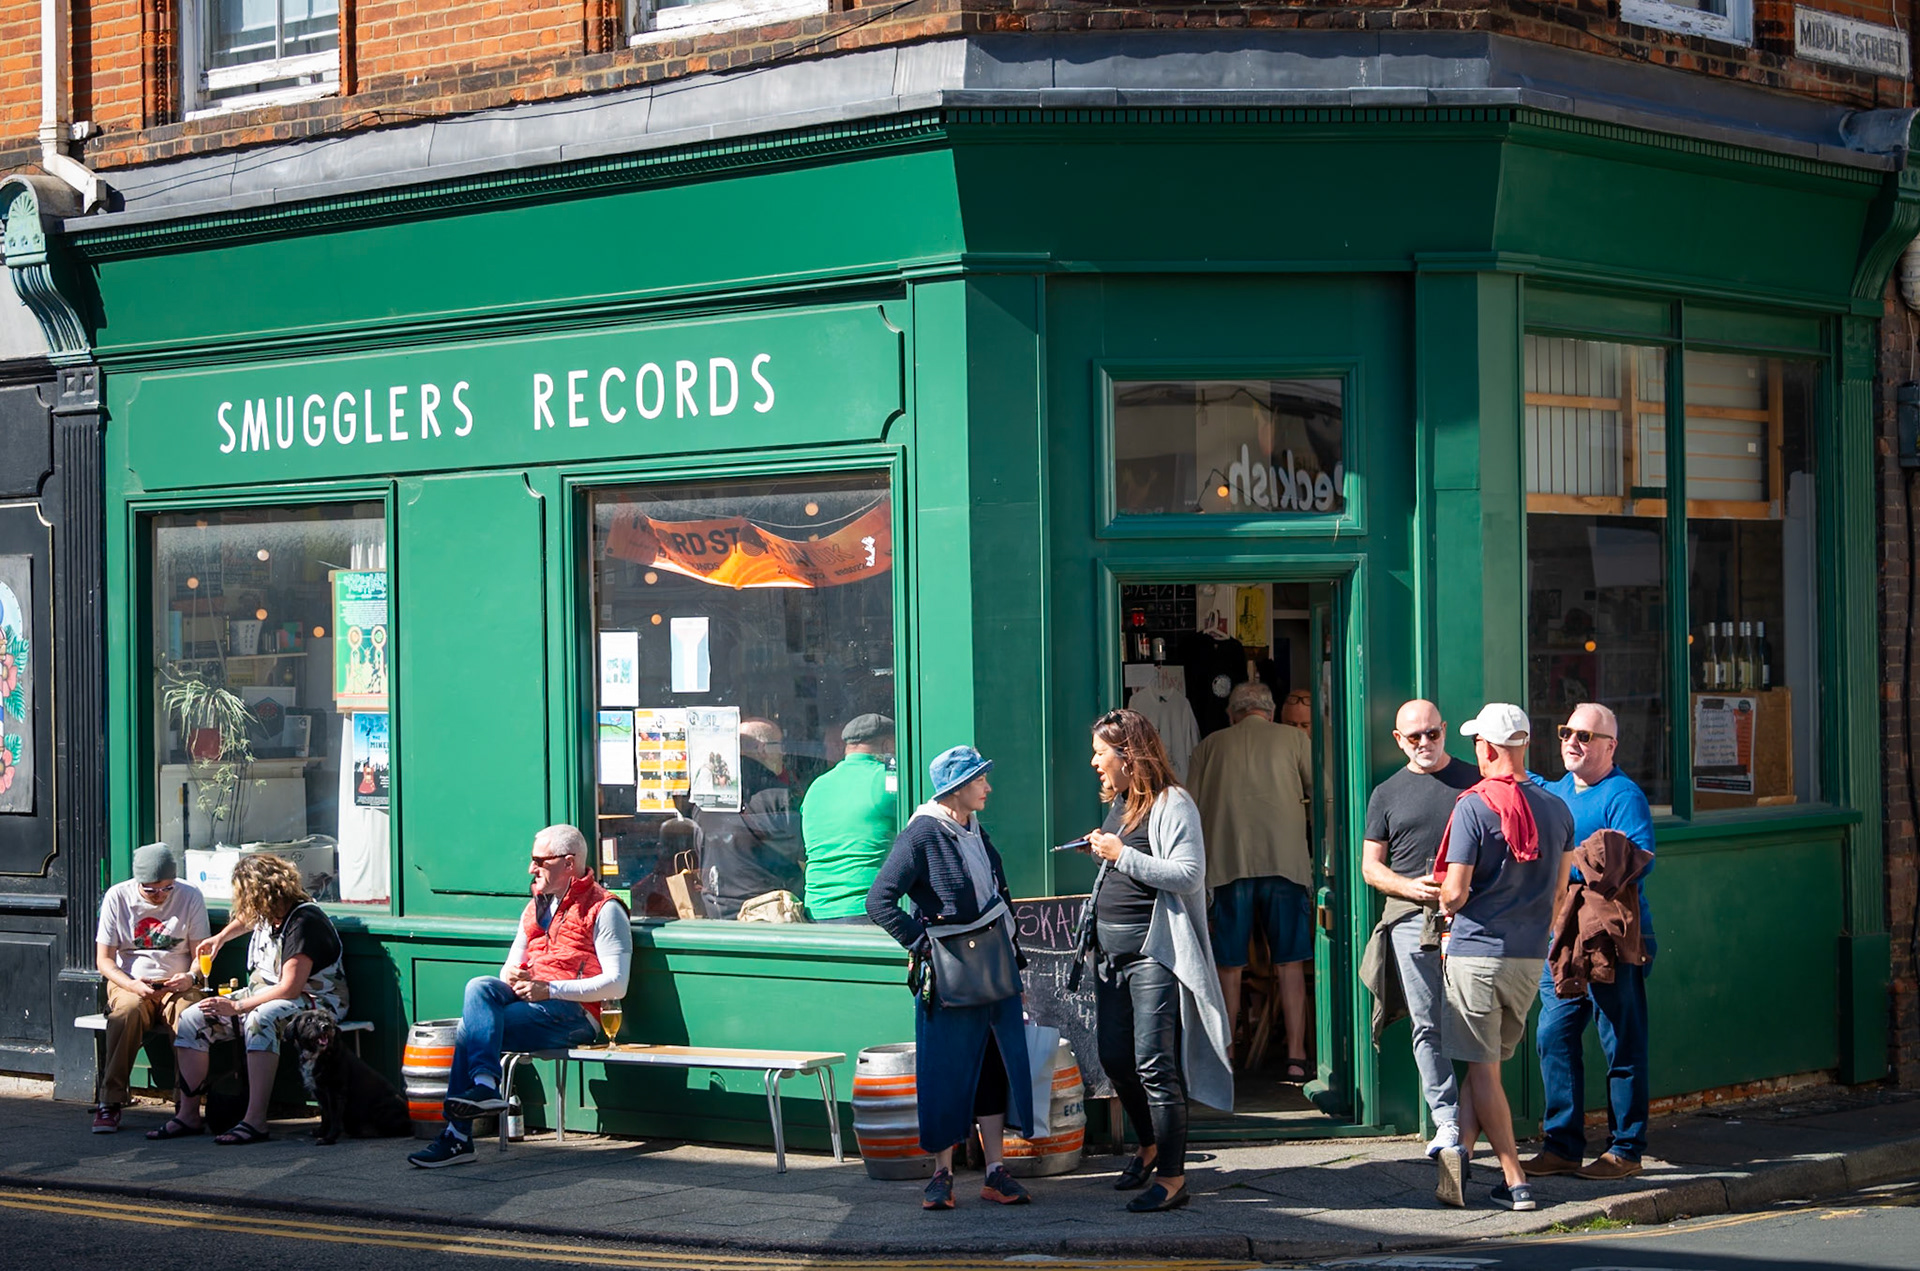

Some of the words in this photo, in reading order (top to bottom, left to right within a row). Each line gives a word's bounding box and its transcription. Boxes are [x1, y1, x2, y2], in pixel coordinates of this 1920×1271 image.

[1800, 19, 1850, 54] MIDDLE
[1855, 31, 1902, 66] STREET
[217, 380, 474, 455] SMUGGLERS
[532, 352, 777, 432] RECORDS
